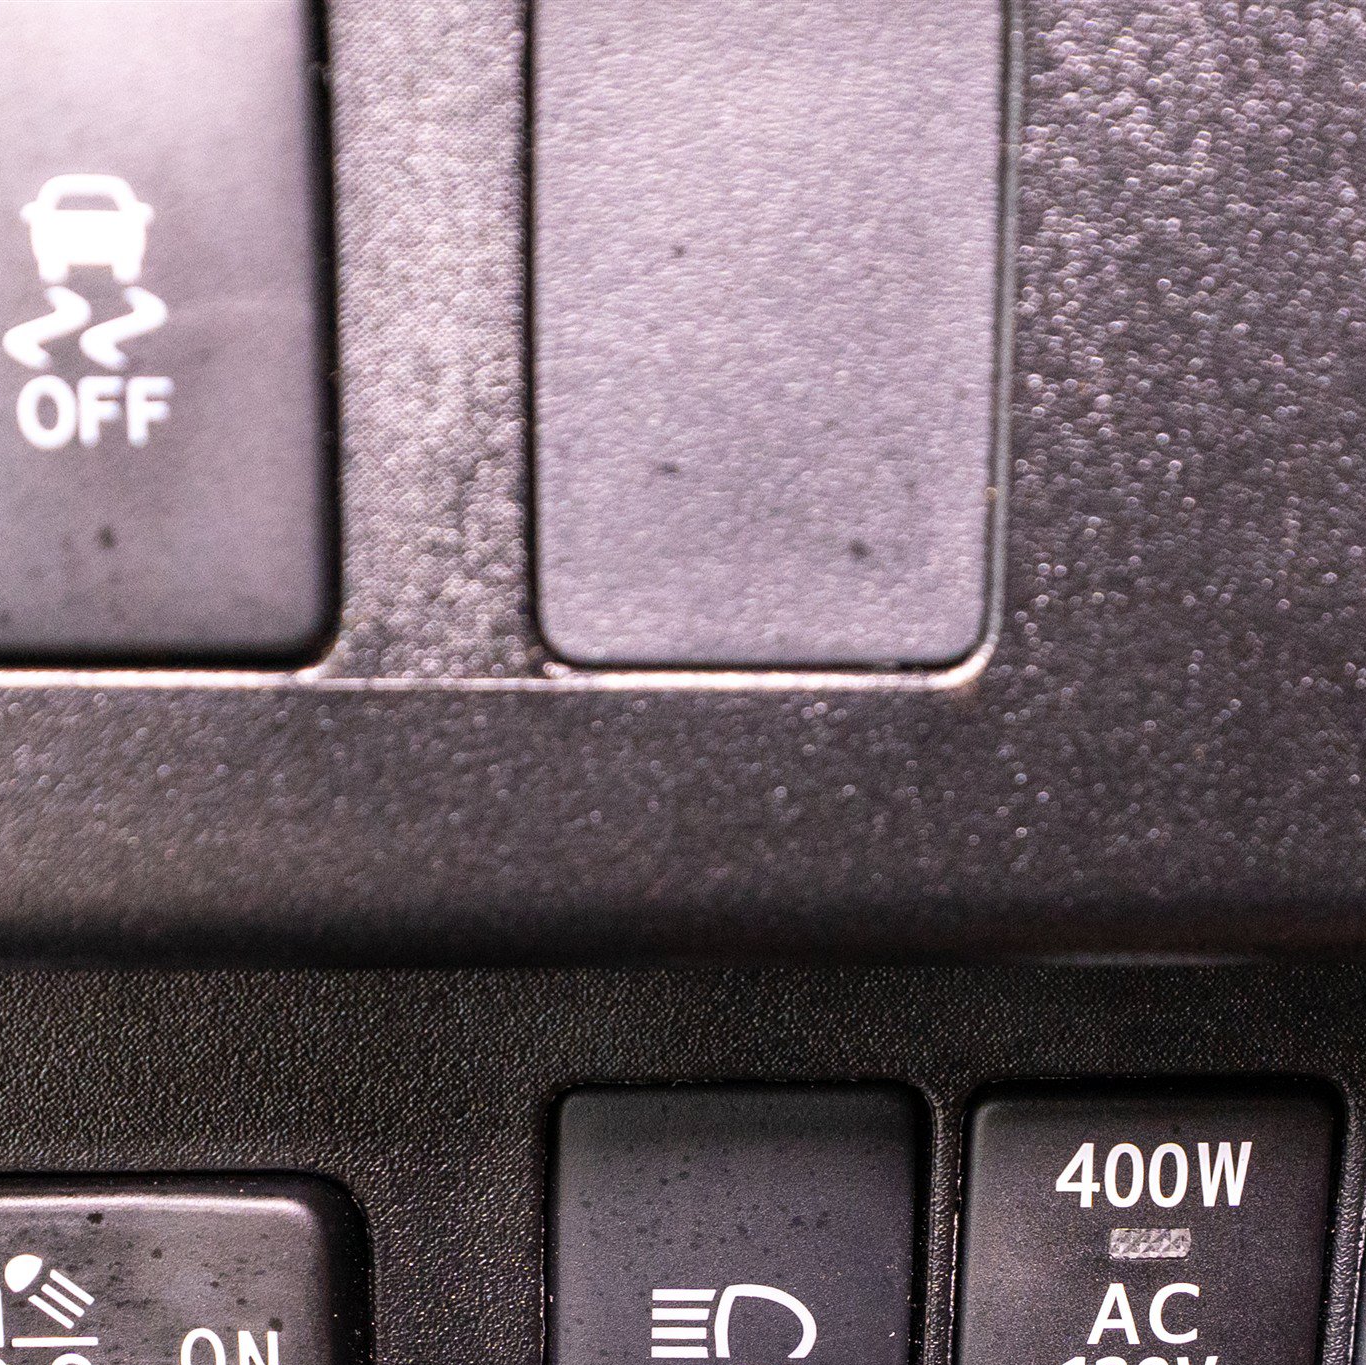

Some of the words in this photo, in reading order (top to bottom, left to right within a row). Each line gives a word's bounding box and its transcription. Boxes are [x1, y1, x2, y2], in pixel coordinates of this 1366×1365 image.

[16, 375, 173, 449] OFF
[1054, 1141, 1253, 1209] 400W
[1086, 1282, 1201, 1346] AC
